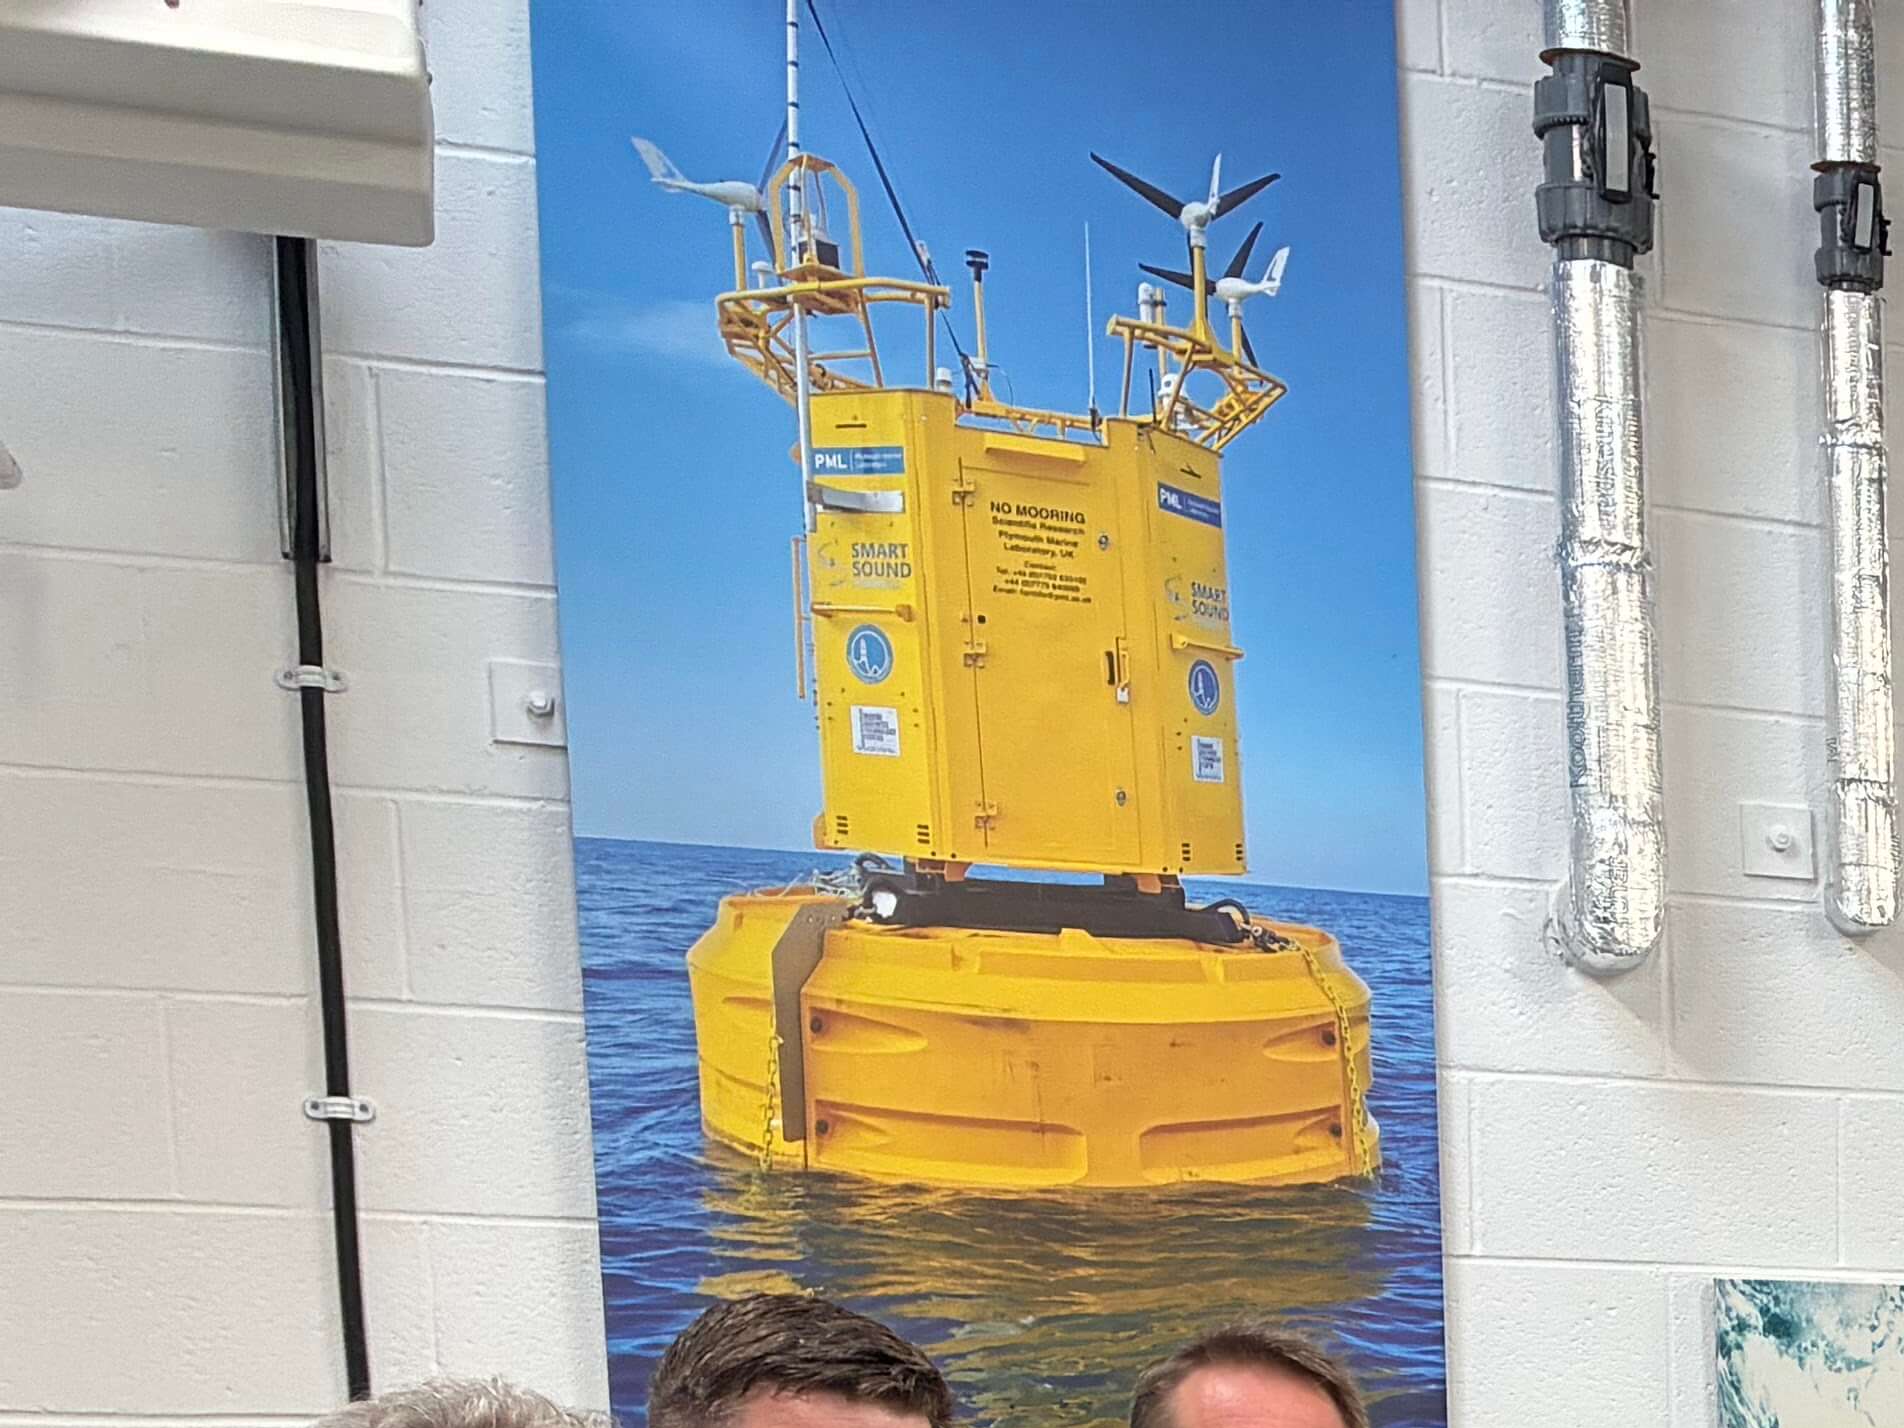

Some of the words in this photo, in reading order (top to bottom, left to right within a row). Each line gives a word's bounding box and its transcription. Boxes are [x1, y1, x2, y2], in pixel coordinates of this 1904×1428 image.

[814, 453, 848, 469] PML
[1160, 487, 1182, 510] PML
[990, 501, 1012, 514] NO
[1015, 504, 1086, 525] MOORING
[1039, 522, 1085, 535] Research
[998, 529, 1044, 543] Plymouth
[1046, 536, 1079, 548] Marine
[851, 543, 909, 559] SMART
[852, 561, 912, 578] SOUND
[1191, 581, 1226, 600] SMART
[1191, 600, 1230, 622] SOUND
